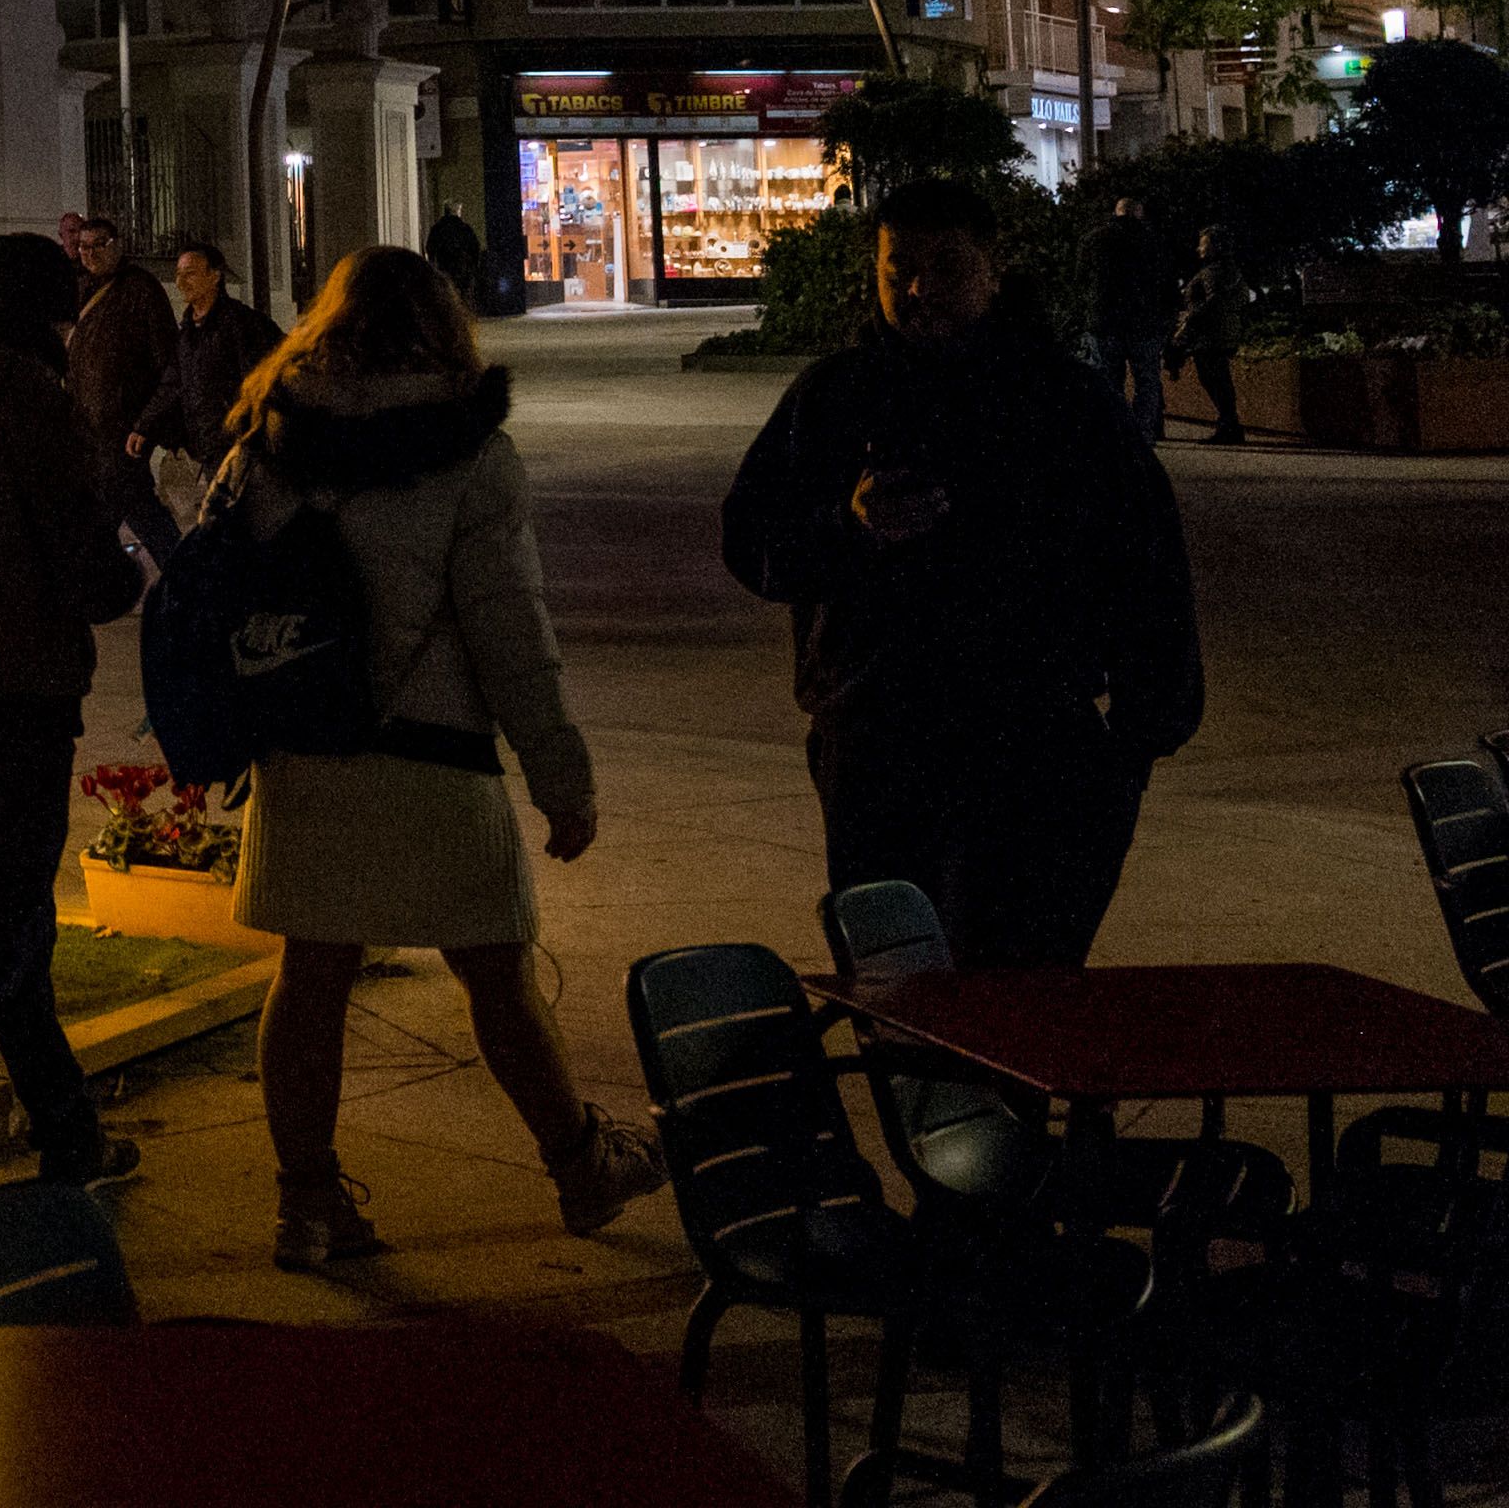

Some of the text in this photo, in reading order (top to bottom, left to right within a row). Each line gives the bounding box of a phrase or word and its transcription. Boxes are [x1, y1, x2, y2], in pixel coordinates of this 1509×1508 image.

[548, 94, 624, 111] TABACS
[676, 94, 748, 111] TIMBRE
[1054, 100, 1080, 125] NAILS
